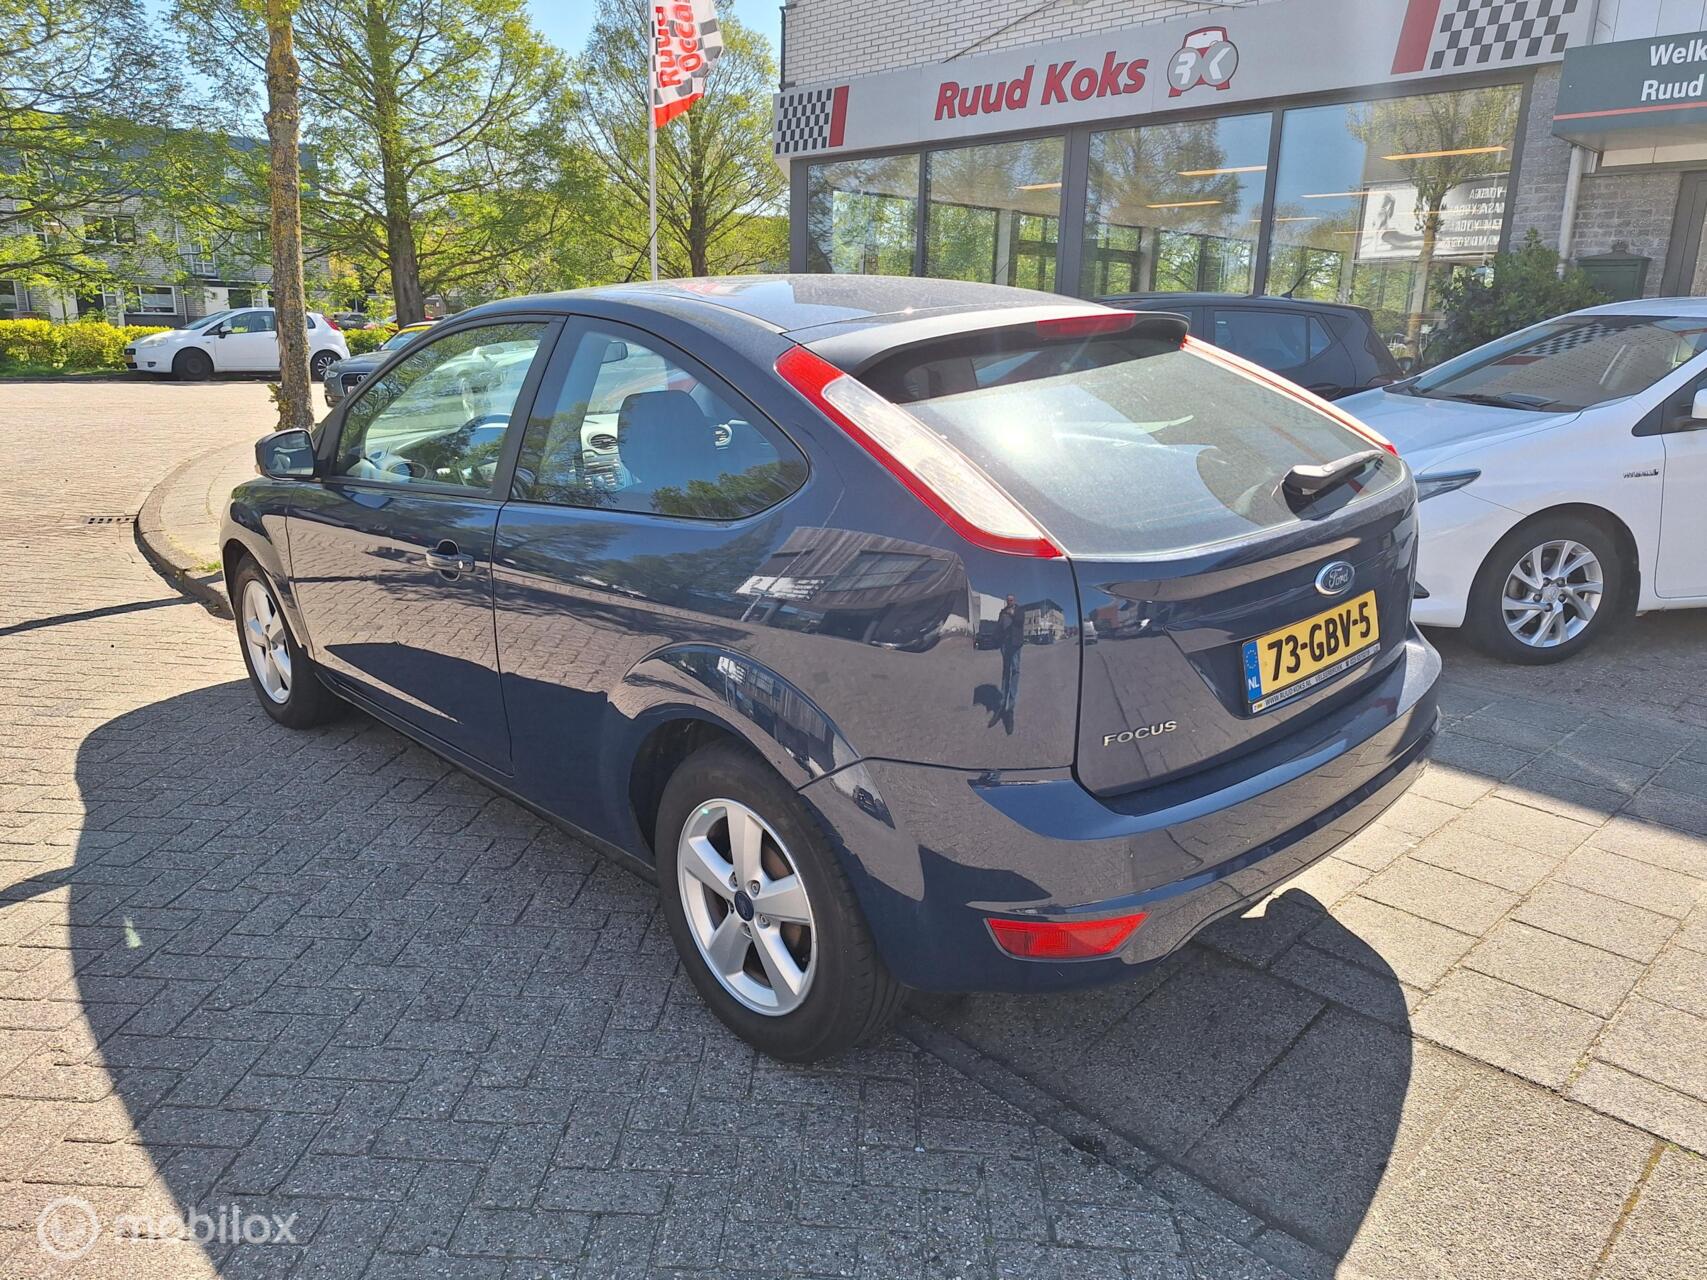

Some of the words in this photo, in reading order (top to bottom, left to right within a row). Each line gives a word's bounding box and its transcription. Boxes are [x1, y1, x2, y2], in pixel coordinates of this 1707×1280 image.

[673, 0, 703, 72] Occa
[1650, 38, 1707, 67] Welk
[934, 65, 1035, 121] Ruud
[1040, 50, 1149, 106] Koks
[1641, 73, 1705, 102] Ruud
[1328, 567, 1349, 589] Ford
[1267, 601, 1371, 682] 73-GBV-5
[1247, 676, 1260, 691] NL
[1103, 720, 1177, 747] FOCUS
